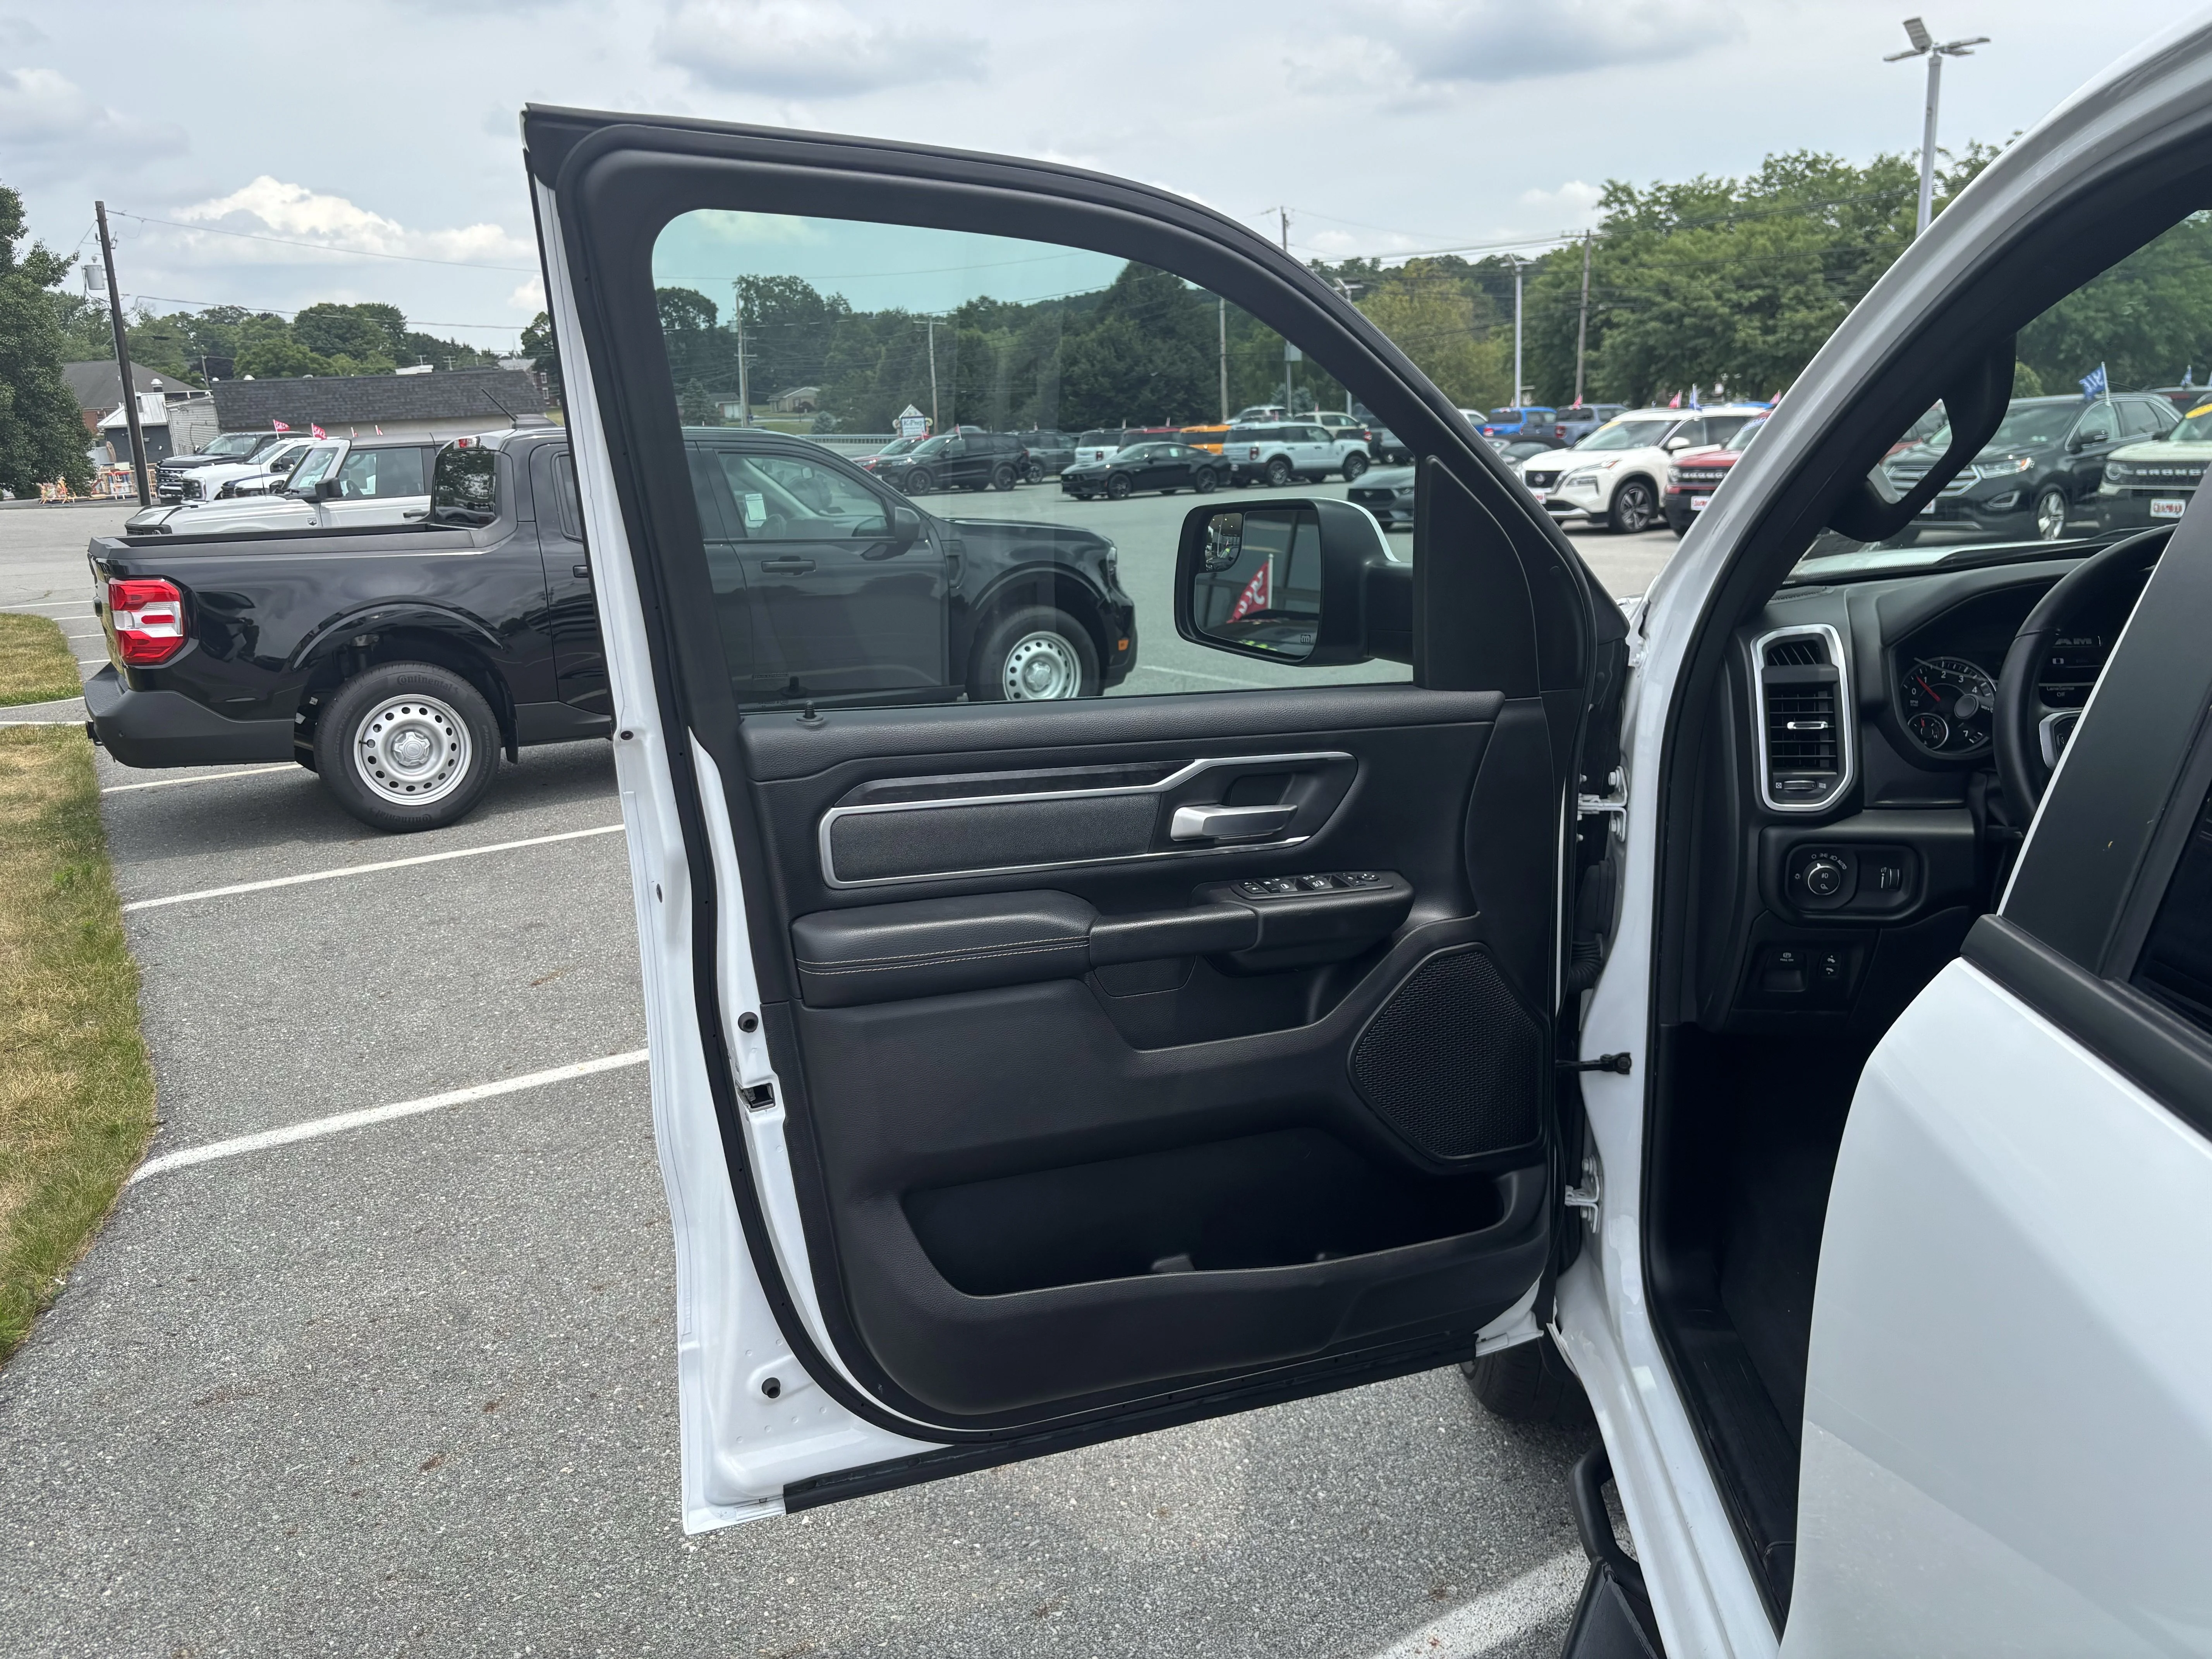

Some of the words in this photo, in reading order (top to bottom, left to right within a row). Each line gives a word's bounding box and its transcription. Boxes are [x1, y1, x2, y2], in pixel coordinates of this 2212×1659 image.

[1941, 670, 1946, 679] 2
[1958, 675, 1964, 683] 3
[397, 674, 453, 692] Continental
[1911, 687, 1917, 696] 0
[1836, 859, 1847, 870] AUTO
